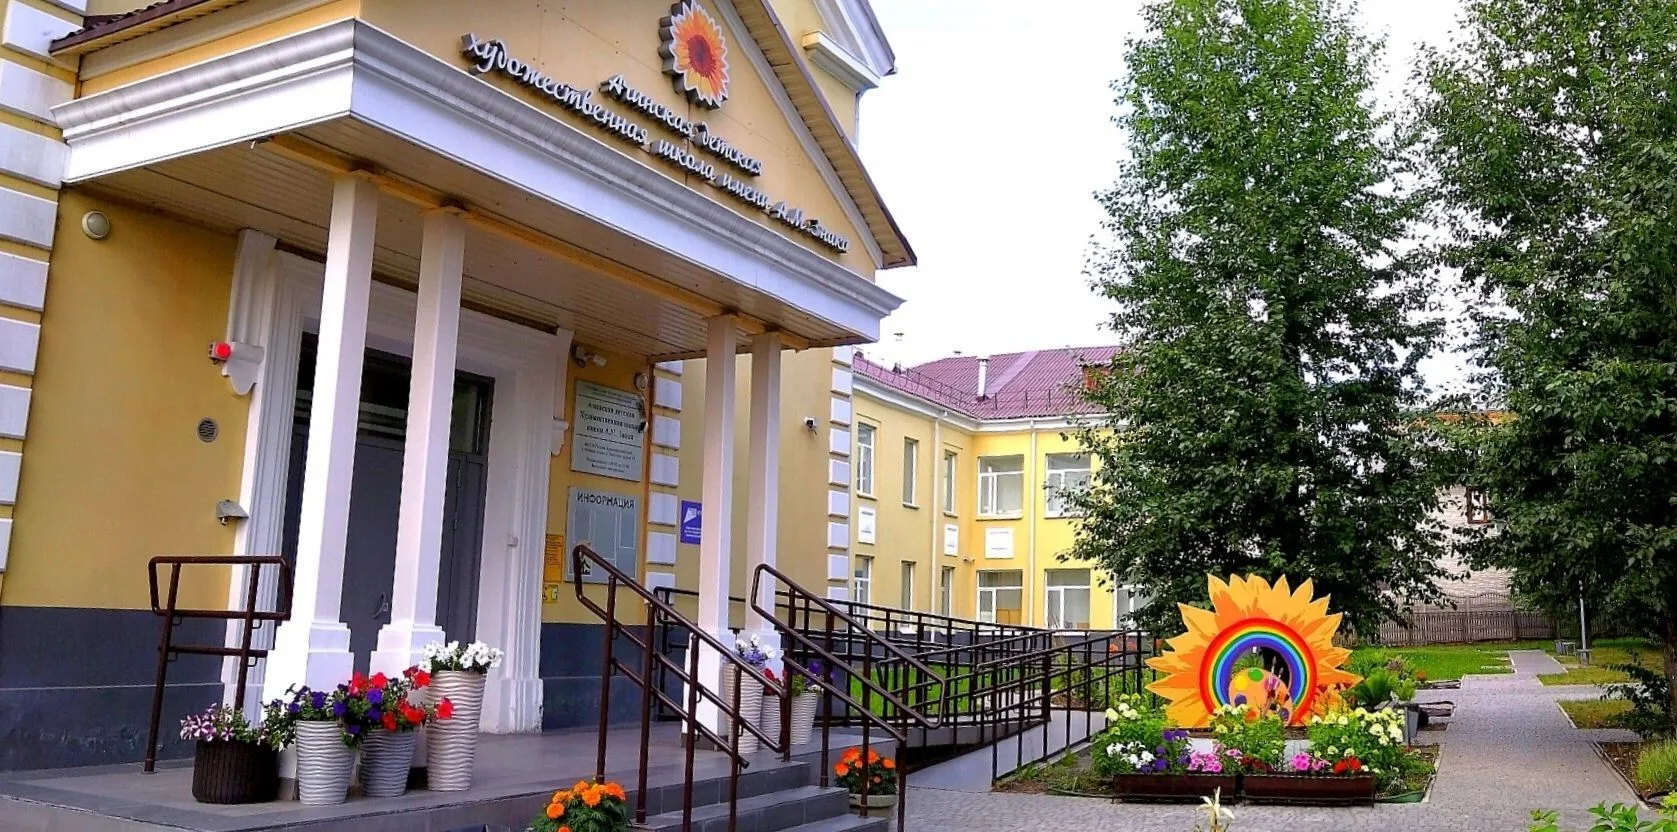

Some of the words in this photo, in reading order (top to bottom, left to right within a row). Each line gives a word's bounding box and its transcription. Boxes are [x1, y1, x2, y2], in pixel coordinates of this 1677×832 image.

[607, 73, 697, 138] Ачинская
[701, 121, 763, 176] детская
[658, 138, 717, 182] школа
[721, 172, 773, 211] имени
[577, 491, 635, 509] ИНФОРМАЦИЯ
